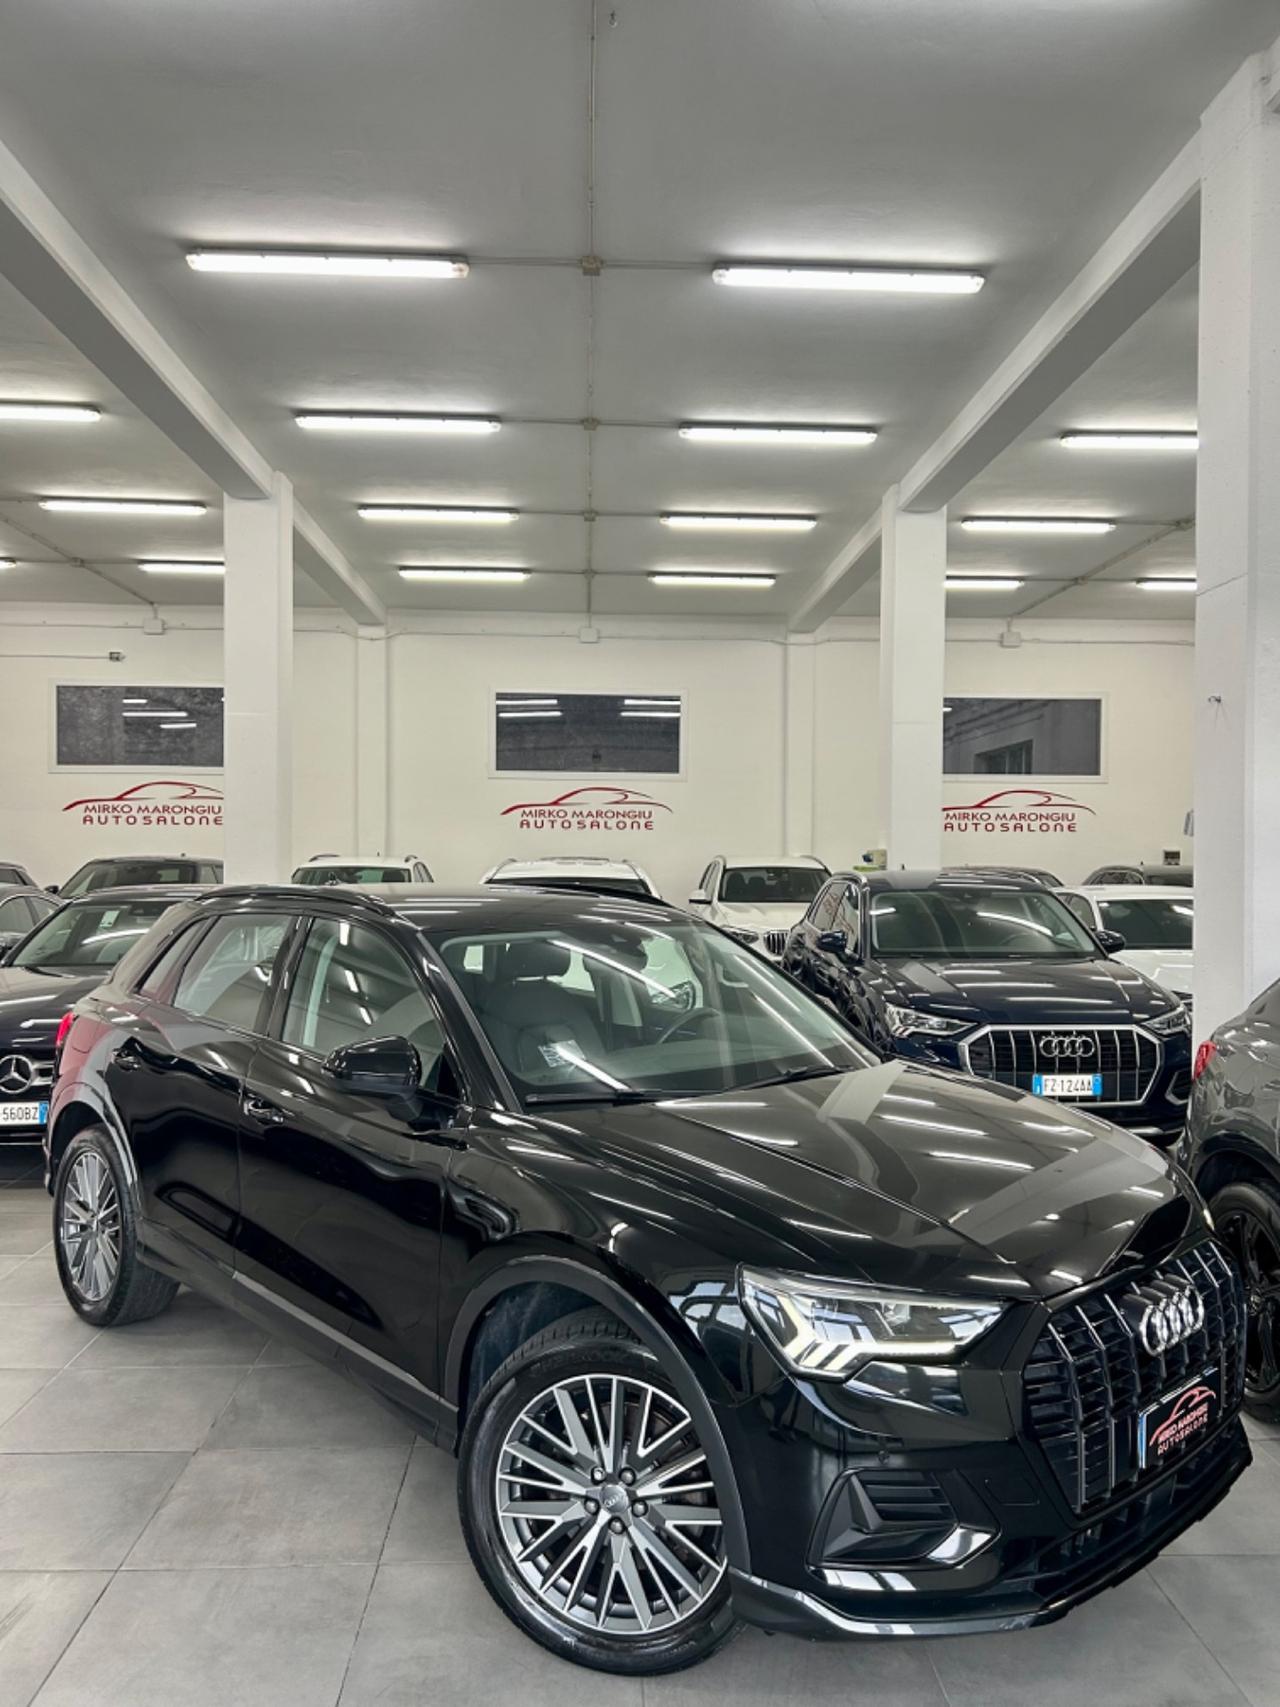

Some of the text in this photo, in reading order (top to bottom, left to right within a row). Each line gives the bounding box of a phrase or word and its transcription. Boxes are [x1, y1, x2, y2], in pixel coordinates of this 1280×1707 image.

[84, 804, 222, 815] MIRKO MARONGIU
[521, 809, 653, 820] MIRKO MARONGIU
[82, 814, 224, 826] AUTOSALONE
[944, 812, 1076, 822] MIRKO MARONGIU
[519, 819, 654, 831] AUTOSALONE
[943, 822, 1077, 833] AUTOSALONE
